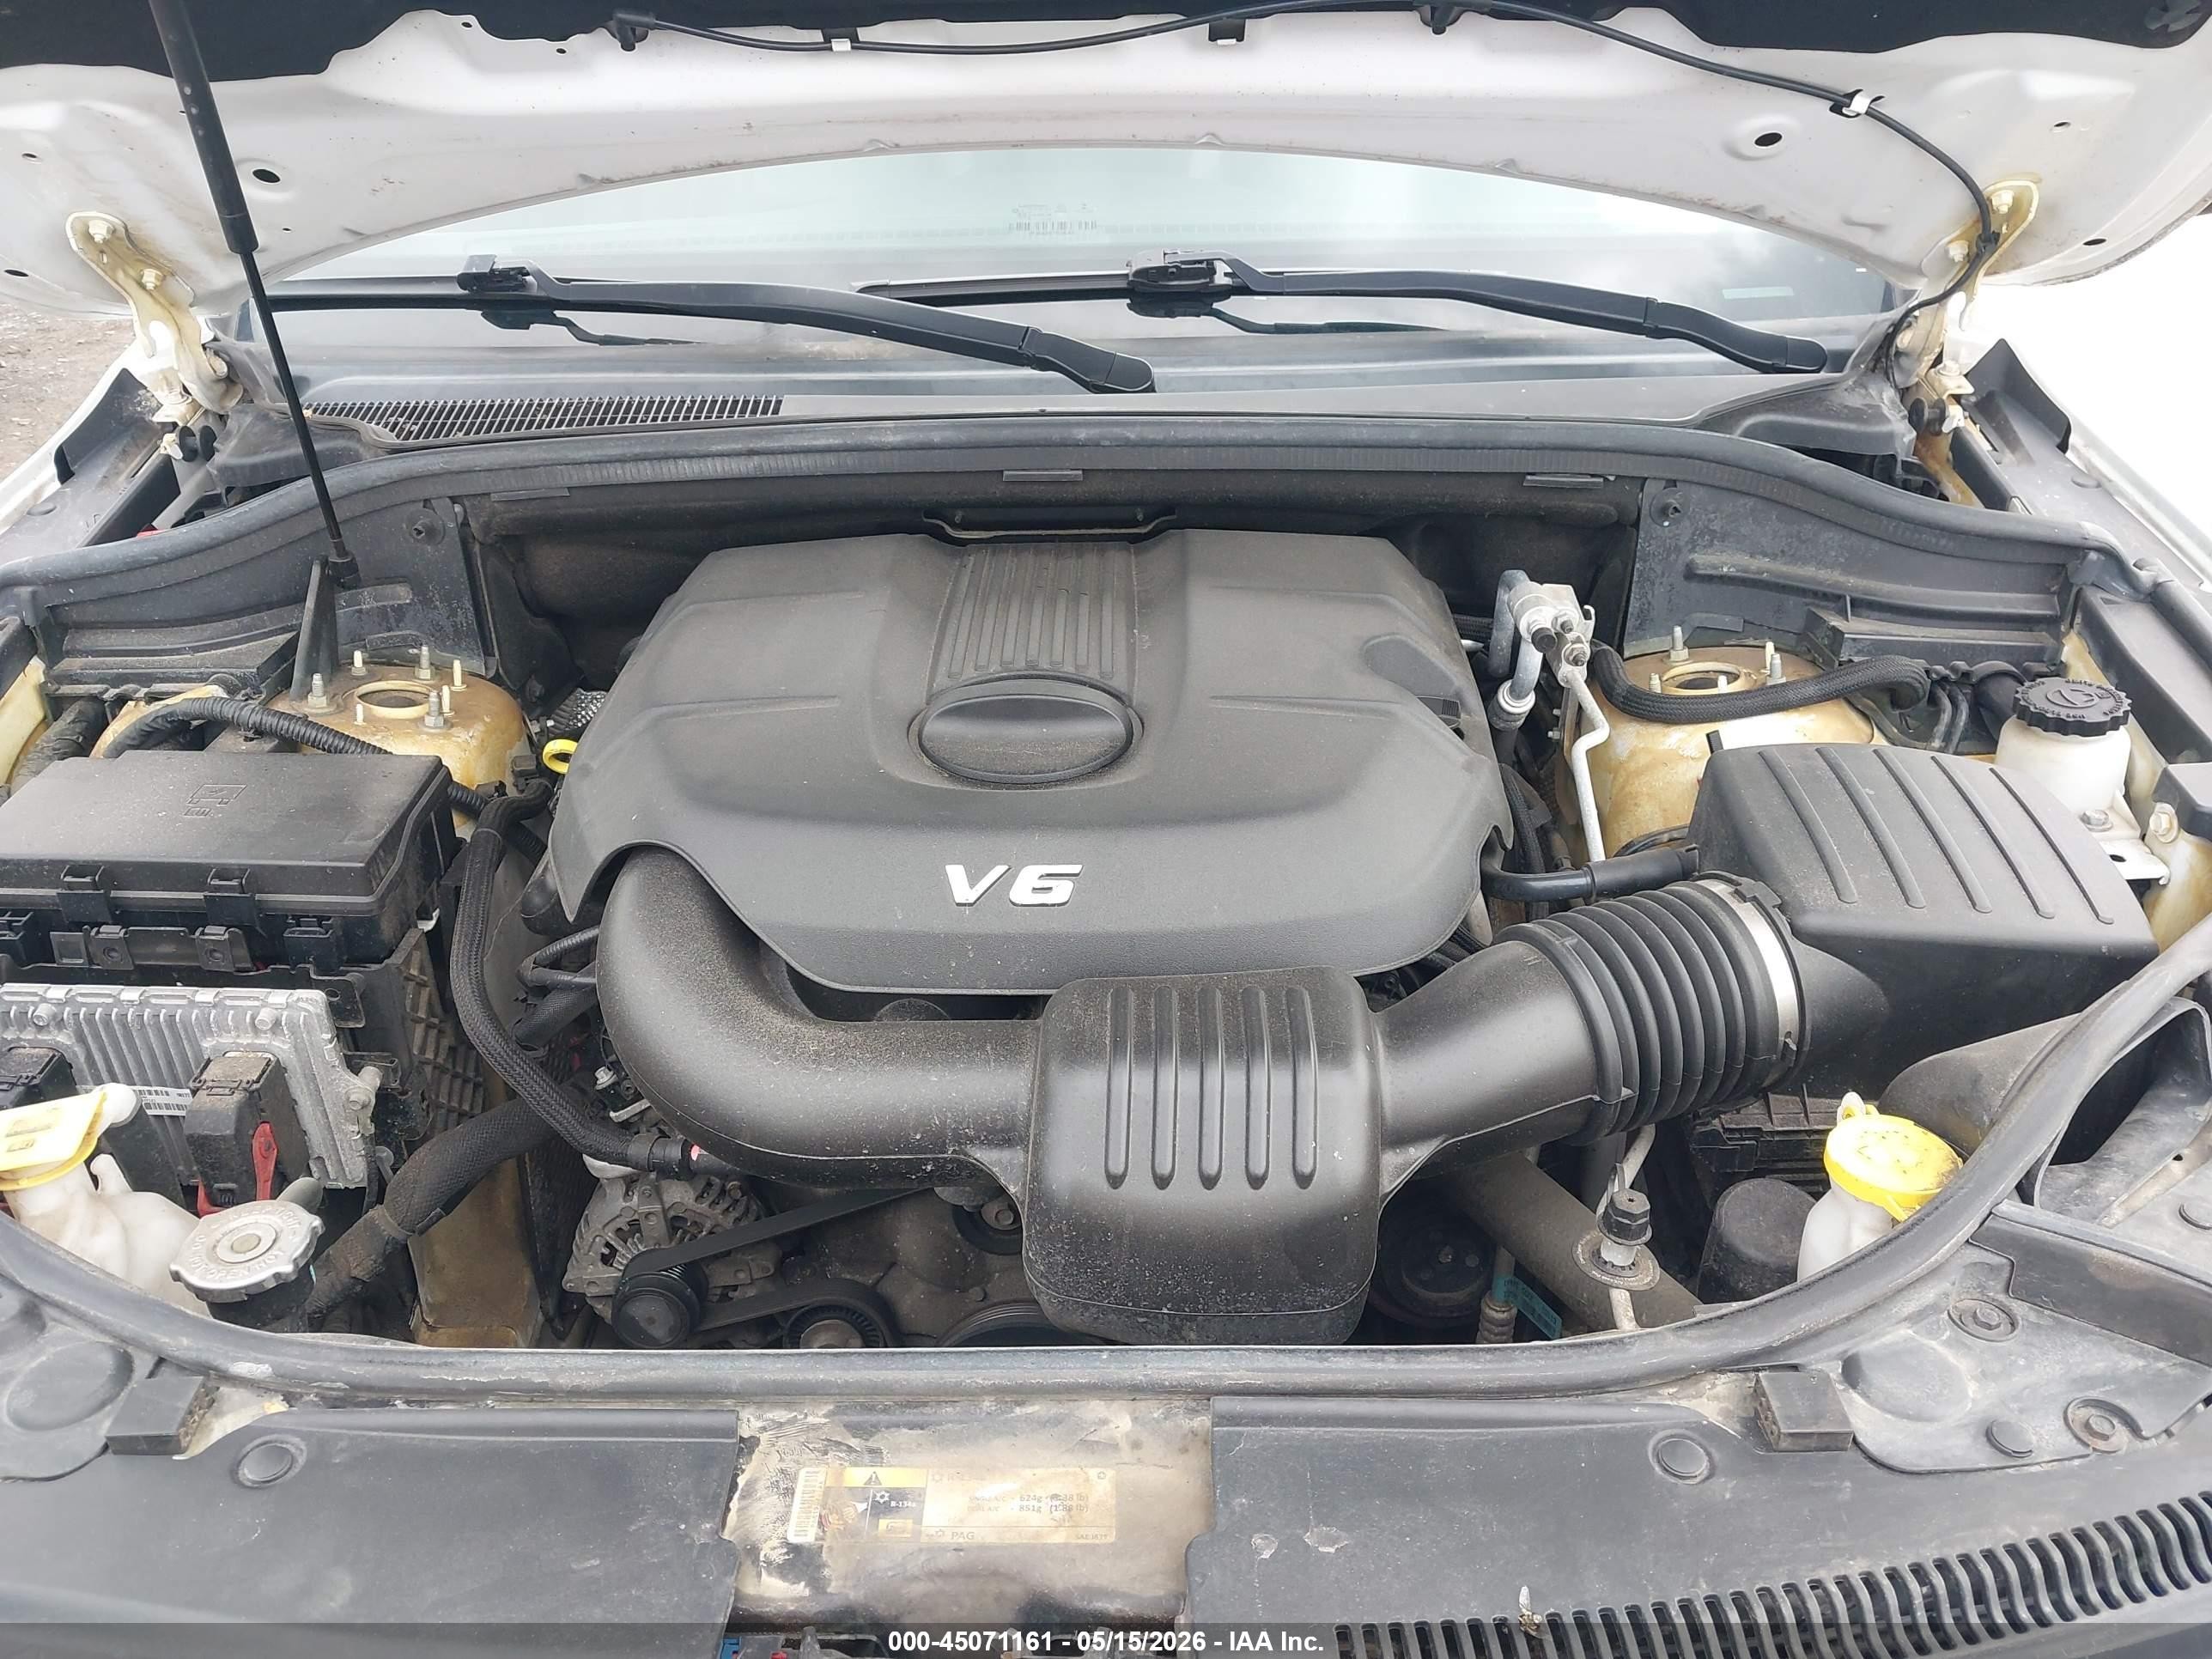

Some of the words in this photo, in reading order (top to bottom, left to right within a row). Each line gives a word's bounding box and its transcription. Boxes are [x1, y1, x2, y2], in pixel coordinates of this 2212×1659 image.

[945, 864, 1084, 907] V6
[205, 1266, 251, 1280] OPEN
[1019, 1495, 1042, 1504] 624g
[1018, 1504, 1042, 1514] 851g
[951, 1531, 975, 1541] PAG
